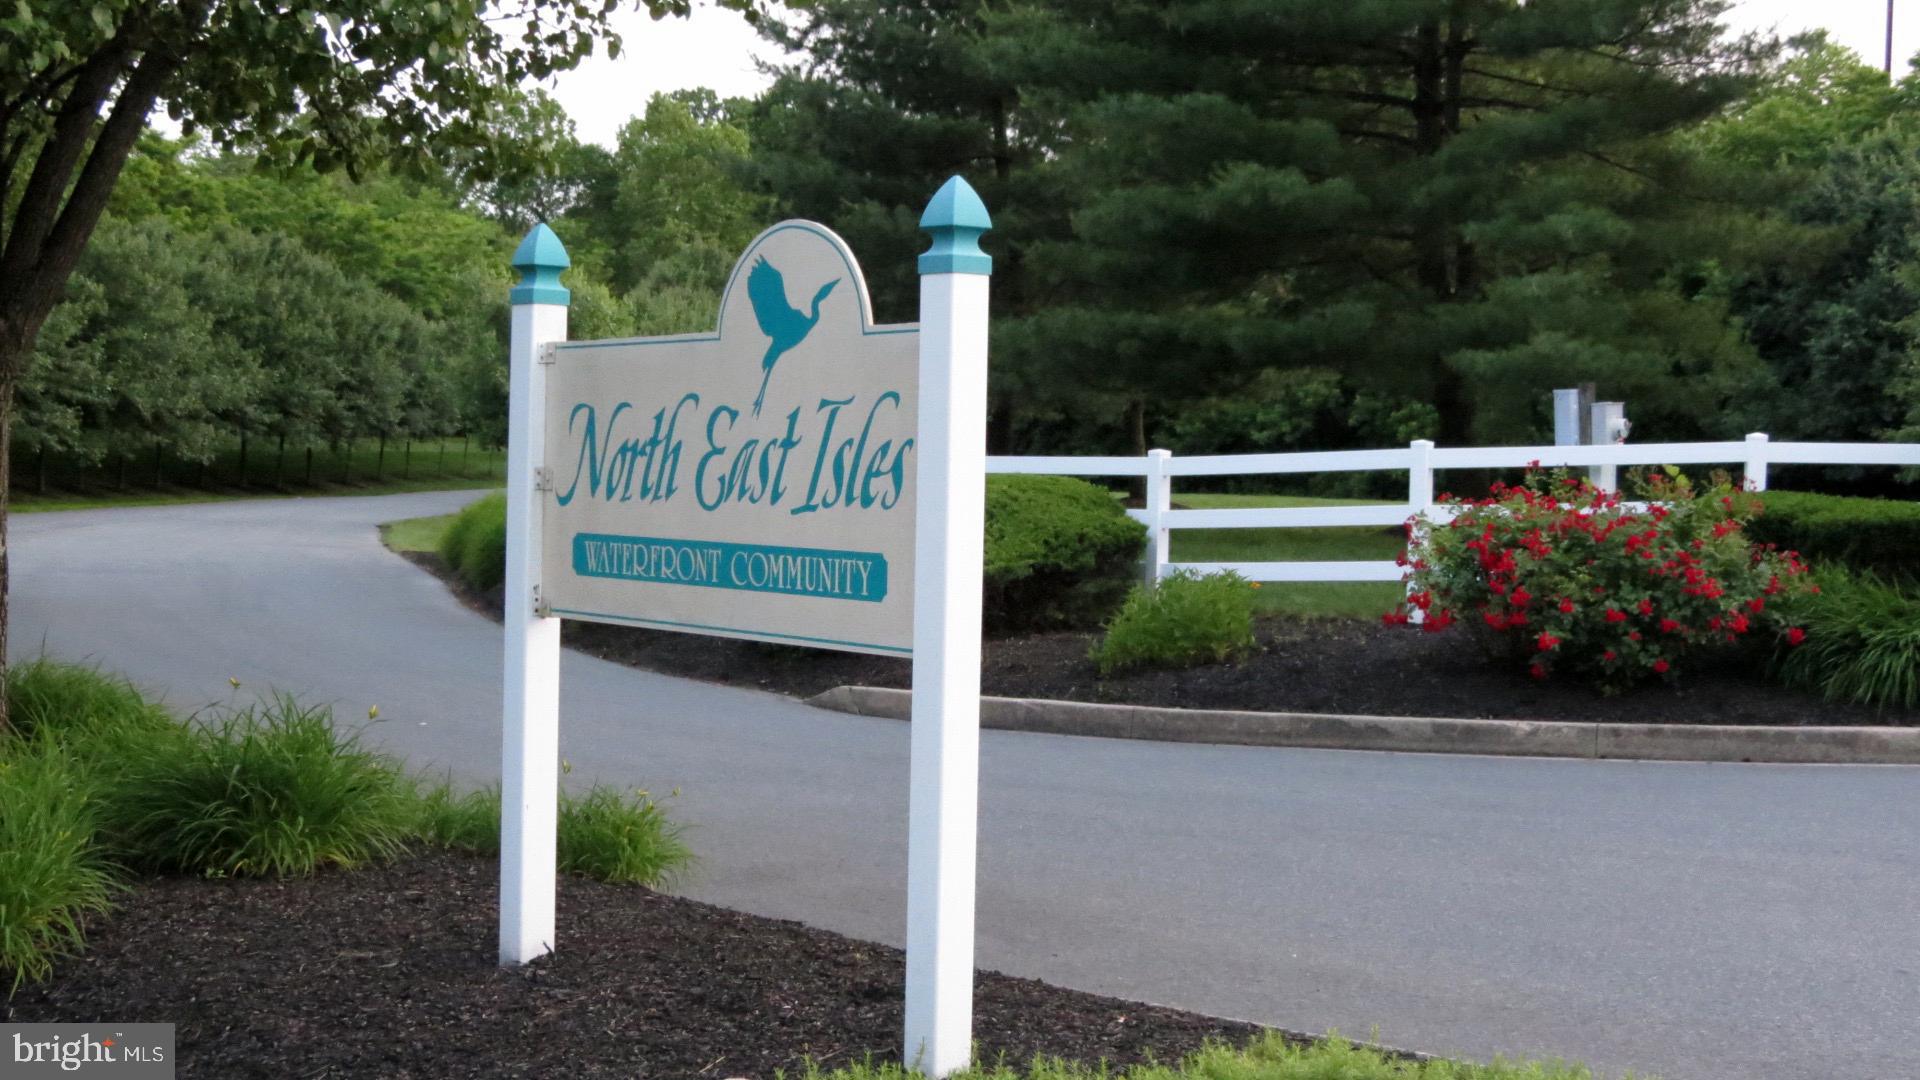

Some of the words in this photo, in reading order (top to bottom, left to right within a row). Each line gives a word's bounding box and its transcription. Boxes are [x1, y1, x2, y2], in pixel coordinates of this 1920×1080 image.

[555, 392, 700, 507] North
[694, 404, 803, 512] East
[790, 390, 914, 516] Isles
[584, 540, 722, 584] WATERFRONT
[730, 551, 873, 597] COMMUNITY
